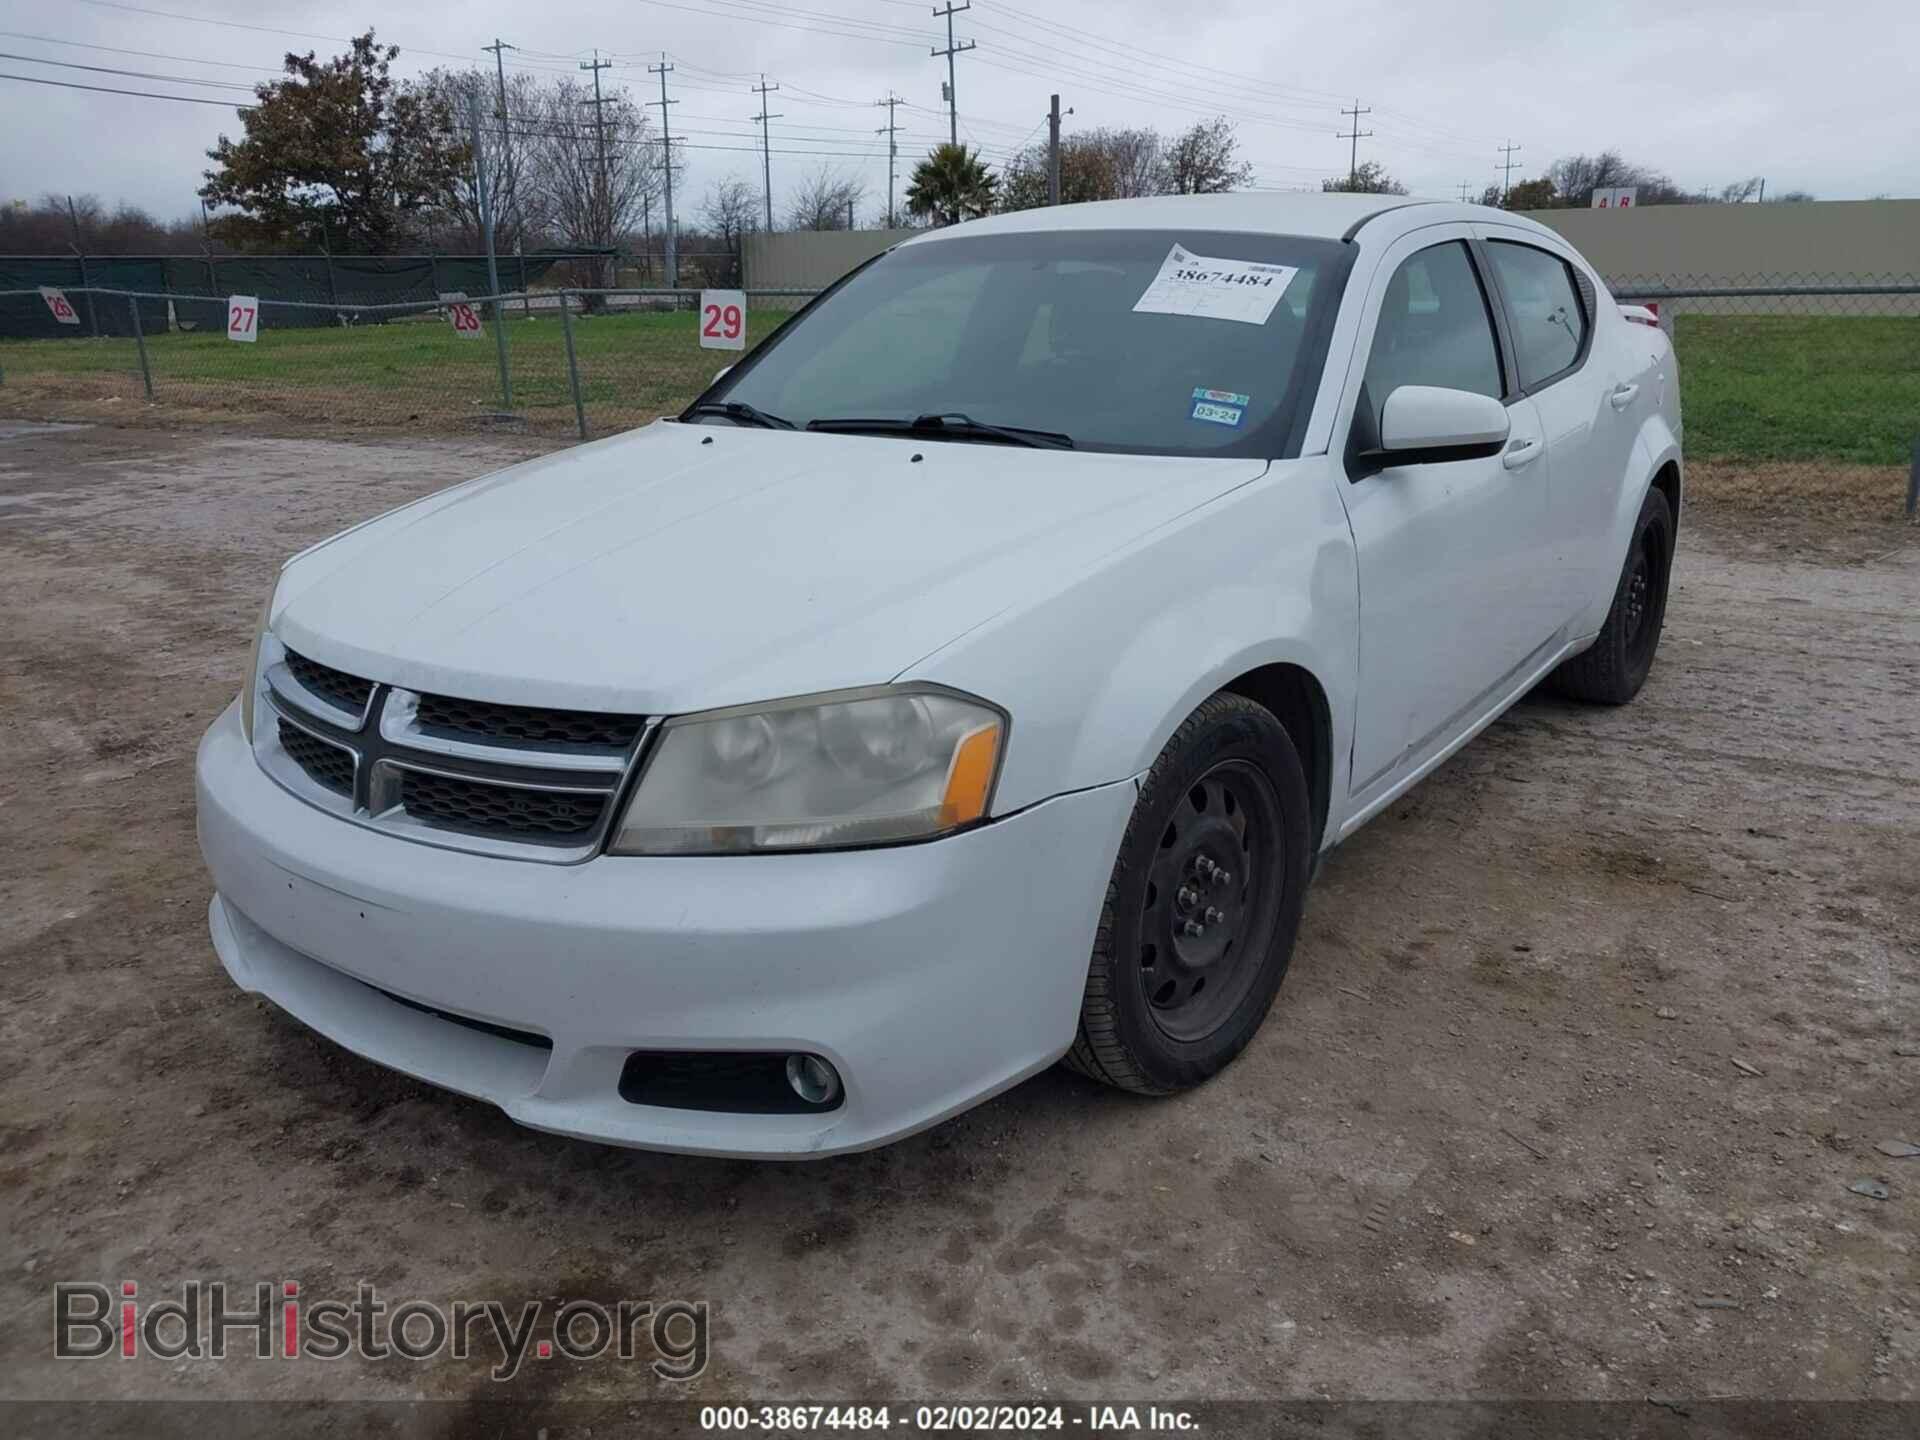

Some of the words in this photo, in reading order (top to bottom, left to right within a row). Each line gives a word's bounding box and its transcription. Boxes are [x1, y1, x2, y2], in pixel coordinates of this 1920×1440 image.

[1169, 269, 1273, 287] 38674484
[230, 306, 256, 333] 27
[449, 303, 479, 330] 28
[703, 304, 741, 339] 29
